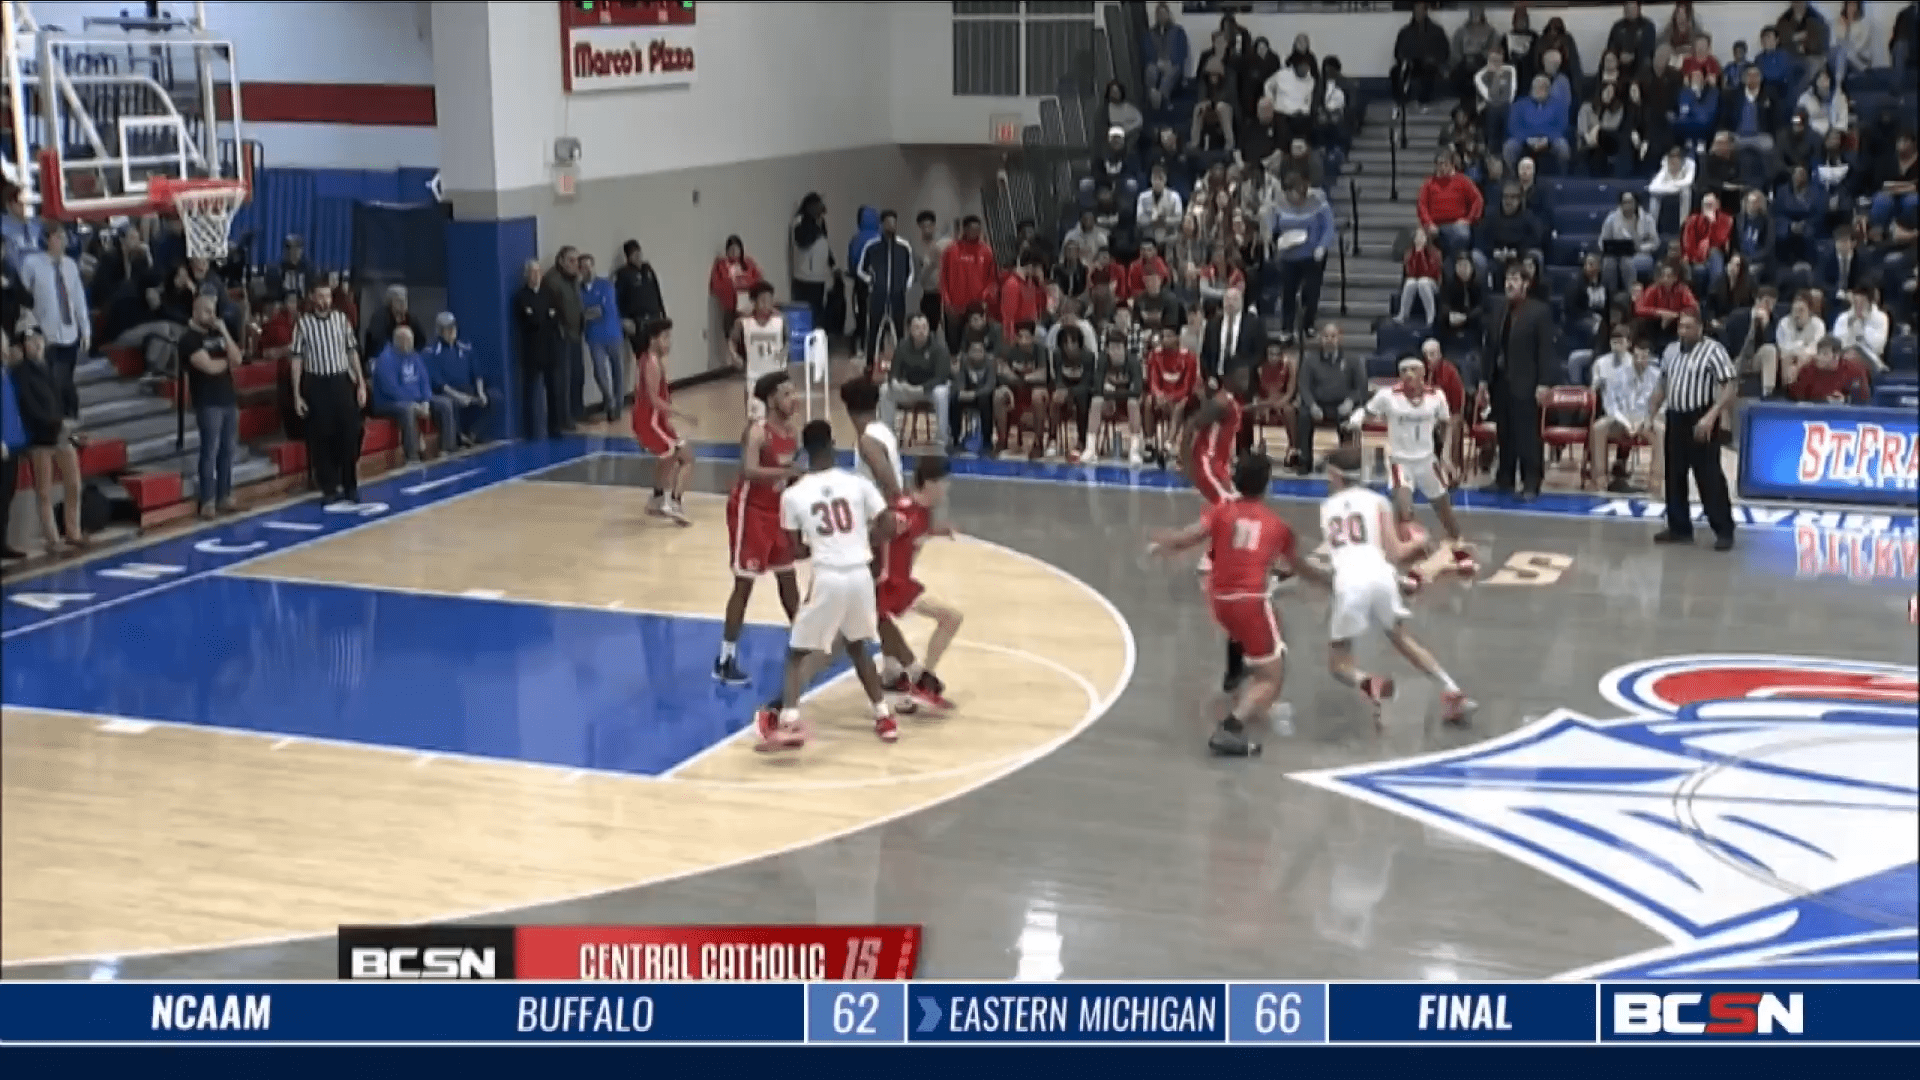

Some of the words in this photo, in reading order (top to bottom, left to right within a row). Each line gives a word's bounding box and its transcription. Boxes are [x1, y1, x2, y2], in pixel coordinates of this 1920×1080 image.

[574, 41, 643, 78] Marco's
[648, 37, 694, 74] Pizza
[811, 497, 853, 536] 30
[1328, 511, 1369, 549] 20
